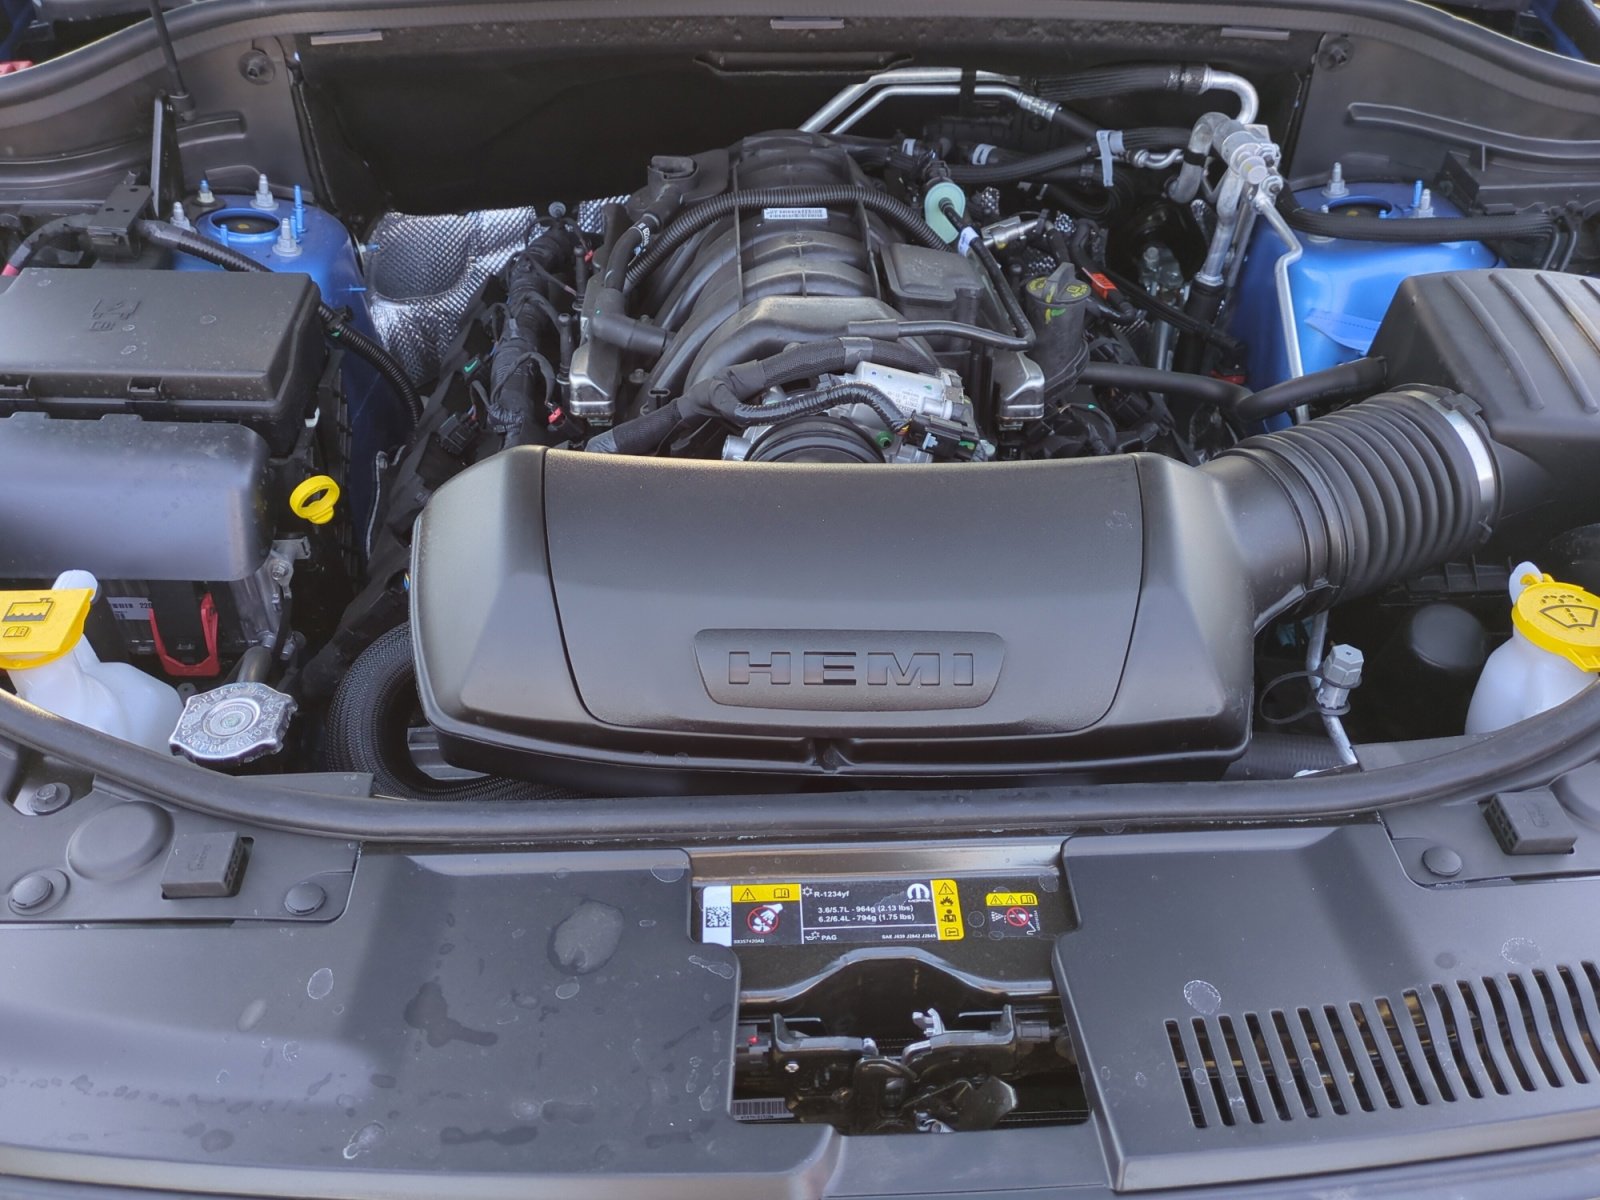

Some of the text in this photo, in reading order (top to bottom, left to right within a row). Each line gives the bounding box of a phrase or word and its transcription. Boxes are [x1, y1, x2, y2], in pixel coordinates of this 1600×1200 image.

[728, 651, 974, 686] HEMI
[813, 890, 850, 898] R-1234yf
[878, 904, 896, 912] (2.13
[878, 914, 898, 922] (1.75
[900, 914, 914, 922] lbs)
